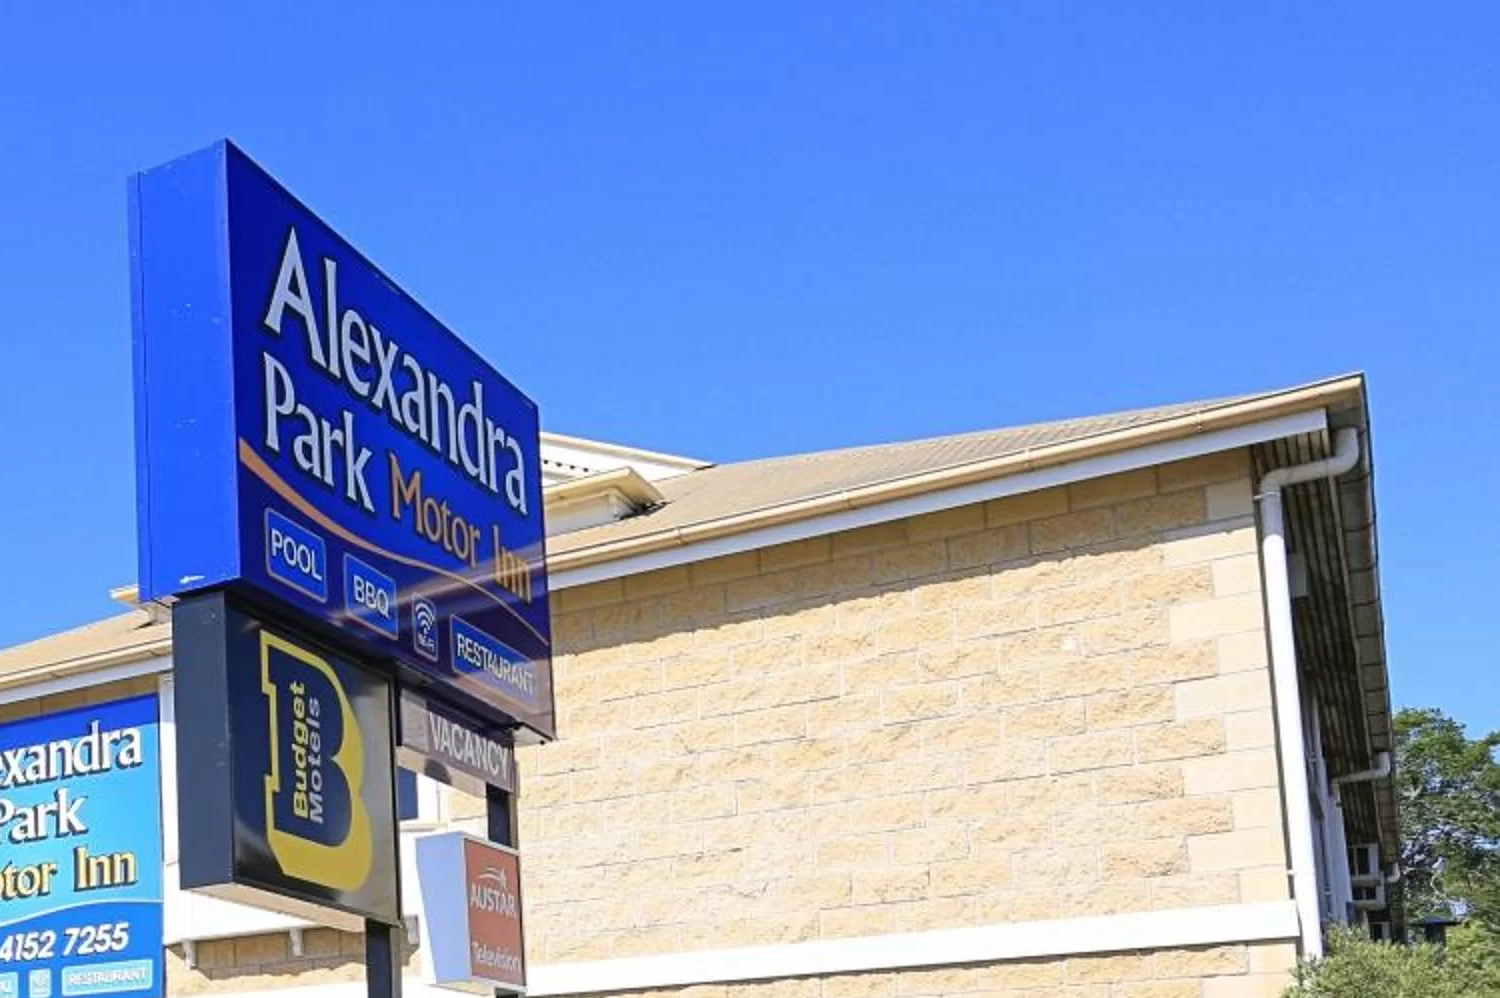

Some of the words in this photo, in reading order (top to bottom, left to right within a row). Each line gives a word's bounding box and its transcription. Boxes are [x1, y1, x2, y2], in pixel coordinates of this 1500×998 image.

[263, 226, 529, 516] Alexandra
[262, 350, 376, 514] Park
[389, 451, 481, 569] Motor
[492, 524, 533, 605] Inn
[270, 527, 323, 582] POOL
[353, 574, 390, 620] BBQ
[456, 632, 534, 696] RESTAURANT
[289, 680, 309, 819] Budget
[306, 696, 324, 825] Motels
[428, 711, 509, 779] VACANCY
[74, 846, 138, 892] Inn
[470, 882, 518, 919] AUSTAR
[62, 921, 131, 957] 7255
